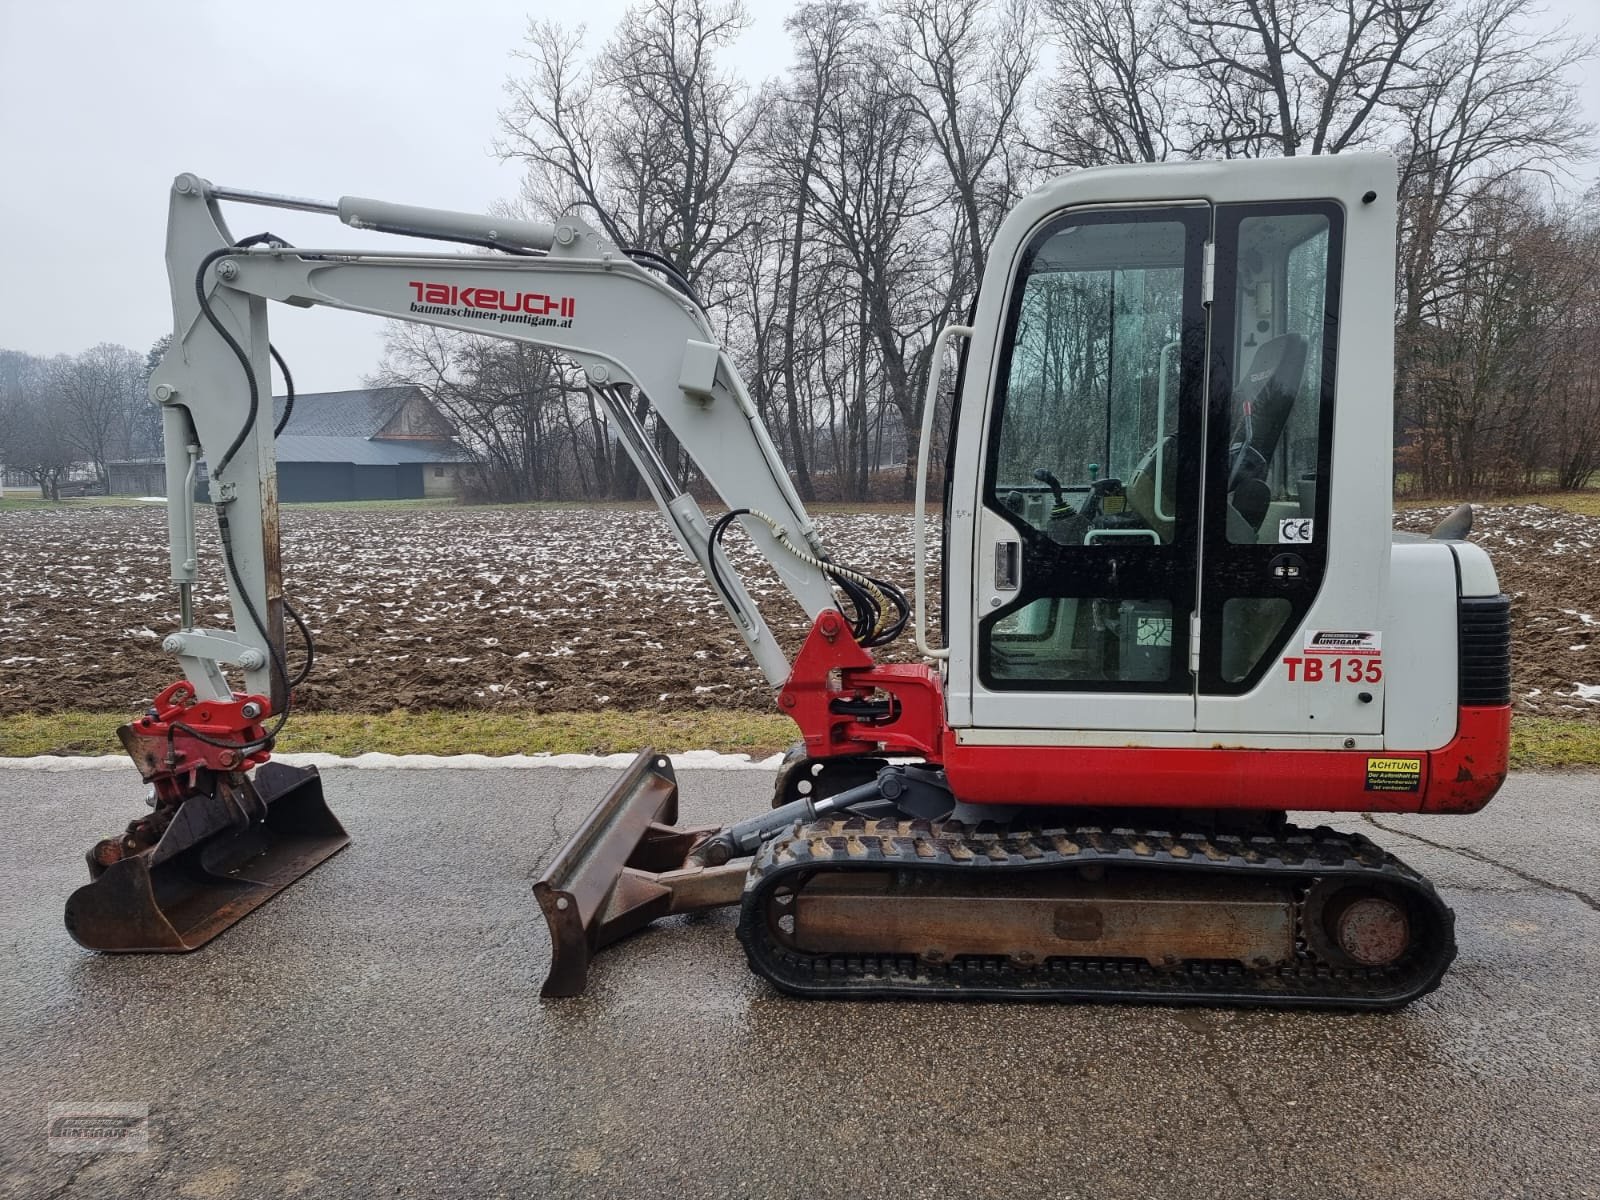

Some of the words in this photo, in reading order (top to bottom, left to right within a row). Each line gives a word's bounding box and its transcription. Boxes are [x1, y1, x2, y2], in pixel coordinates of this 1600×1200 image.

[409, 282, 575, 317] TAKEUCHI
[410, 302, 573, 328] baumaschinen-puntigam.at
[1283, 522, 1310, 540] CE
[1283, 658, 1323, 682] TB
[1329, 659, 1382, 683] 135
[1370, 761, 1418, 770] ACHTUNG
